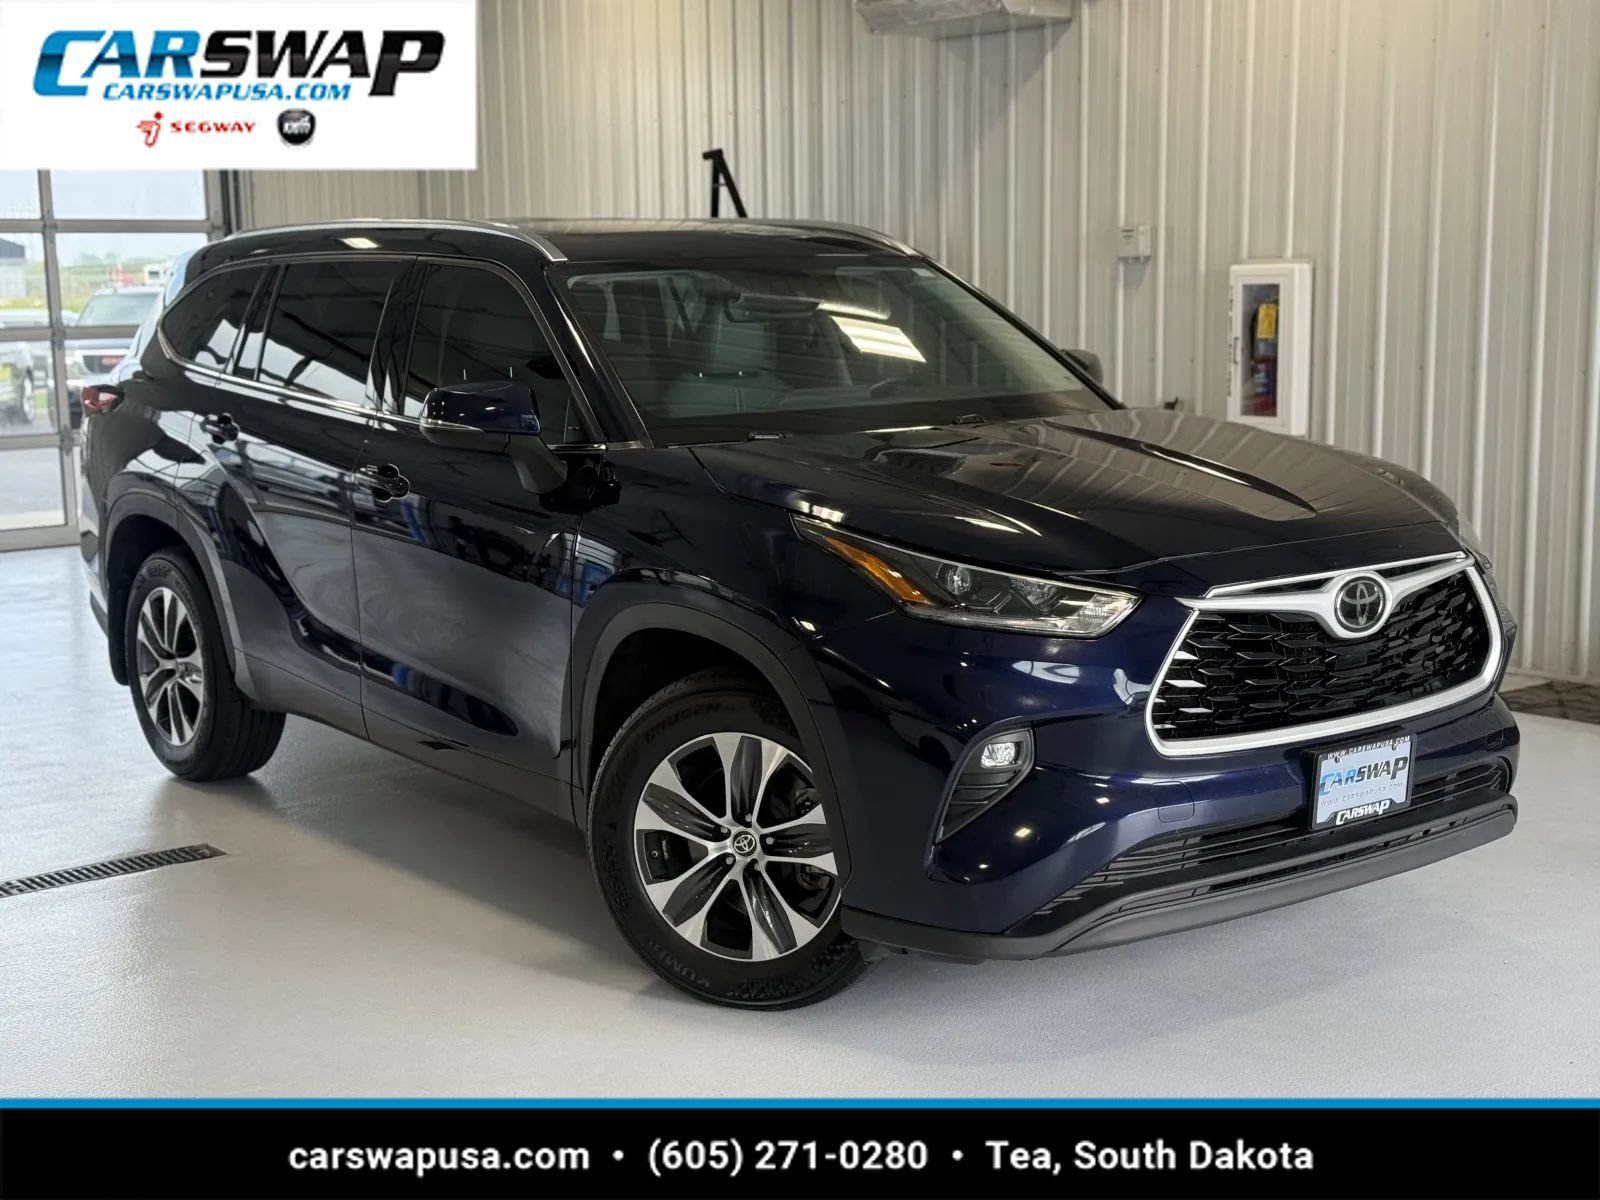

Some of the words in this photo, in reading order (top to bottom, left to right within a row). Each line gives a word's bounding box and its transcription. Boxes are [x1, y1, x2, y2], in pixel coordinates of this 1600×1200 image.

[1327, 736, 1410, 760] WWW.CARSWAPUSA.COM
[1319, 756, 1408, 797] CARSWAP
[1336, 799, 1390, 825] CARSWAP
